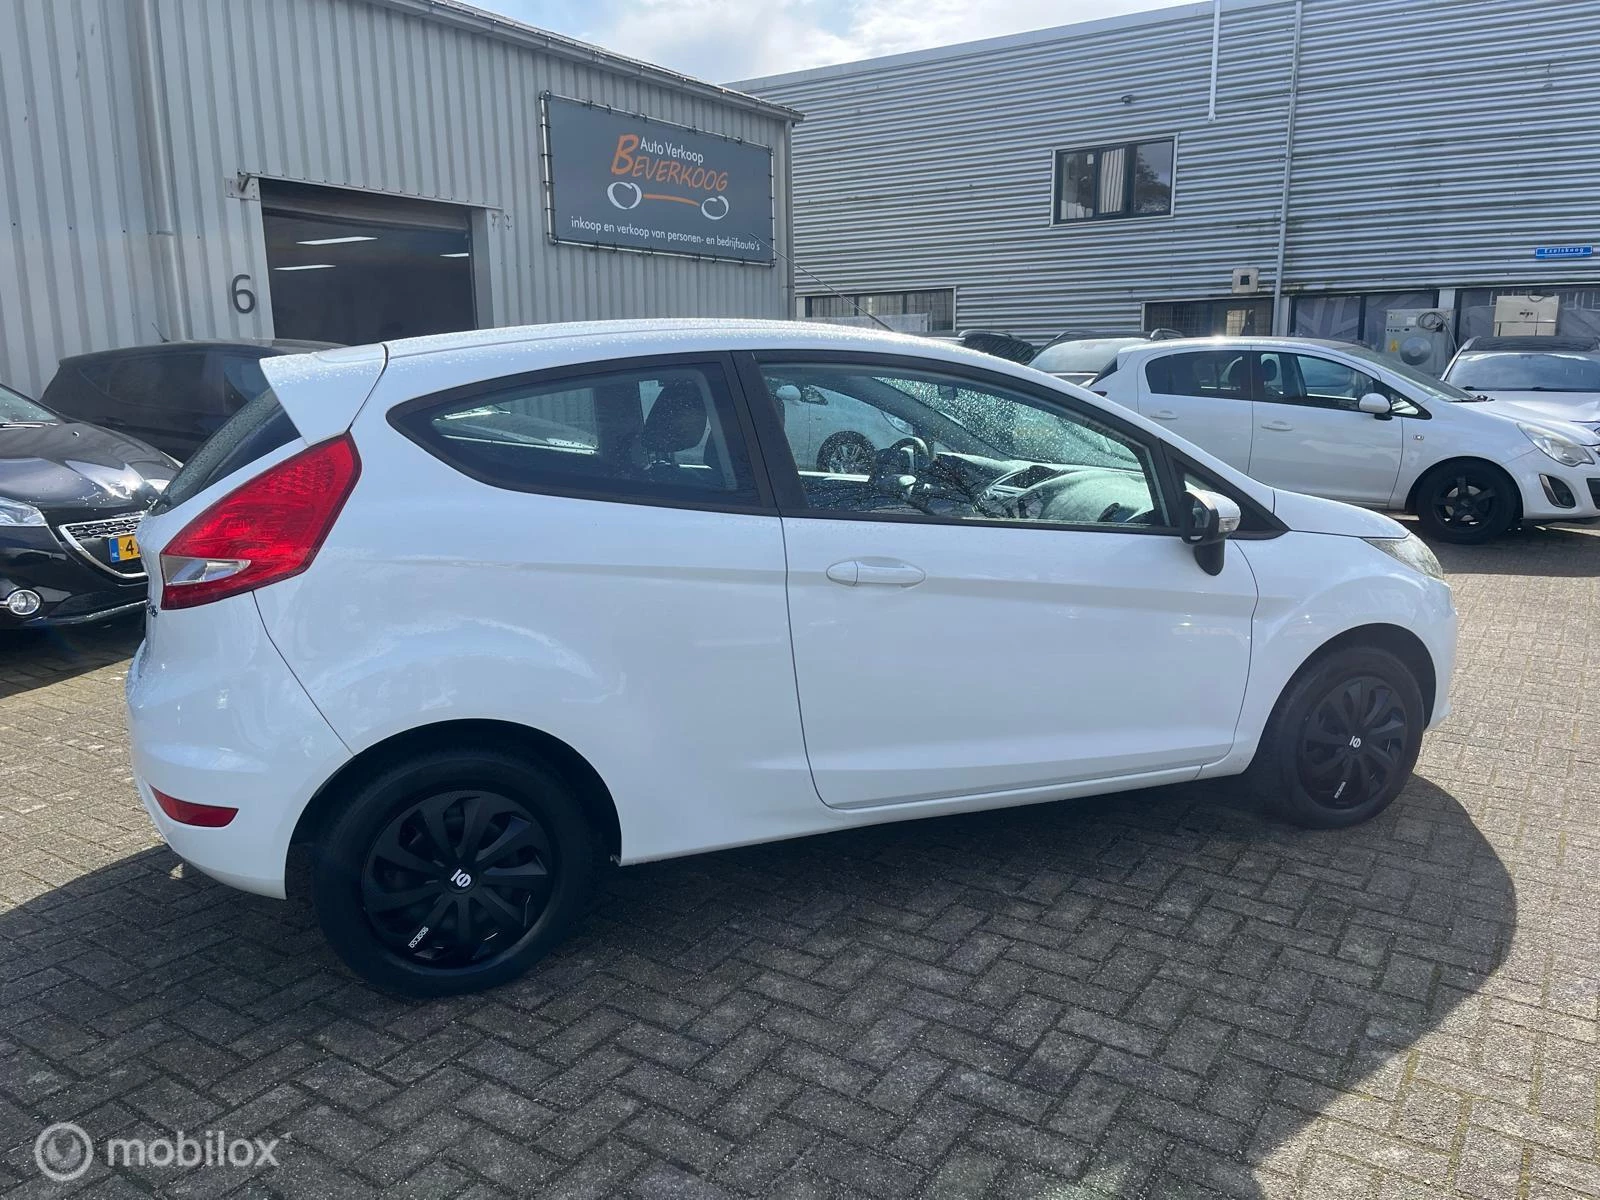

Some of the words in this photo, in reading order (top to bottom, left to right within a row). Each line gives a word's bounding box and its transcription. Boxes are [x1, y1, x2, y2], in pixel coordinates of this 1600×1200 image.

[611, 133, 729, 192] BEVERKOOG
[640, 136, 664, 155] Auto
[665, 142, 704, 166] Verkoop
[571, 215, 602, 234] inkoop
[603, 223, 615, 233] en
[616, 223, 650, 239] verkoop
[651, 229, 666, 239] van
[667, 231, 705, 244] personen-
[706, 236, 715, 245] en
[716, 234, 760, 251] bedrijfsauto's
[231, 273, 256, 314] 6
